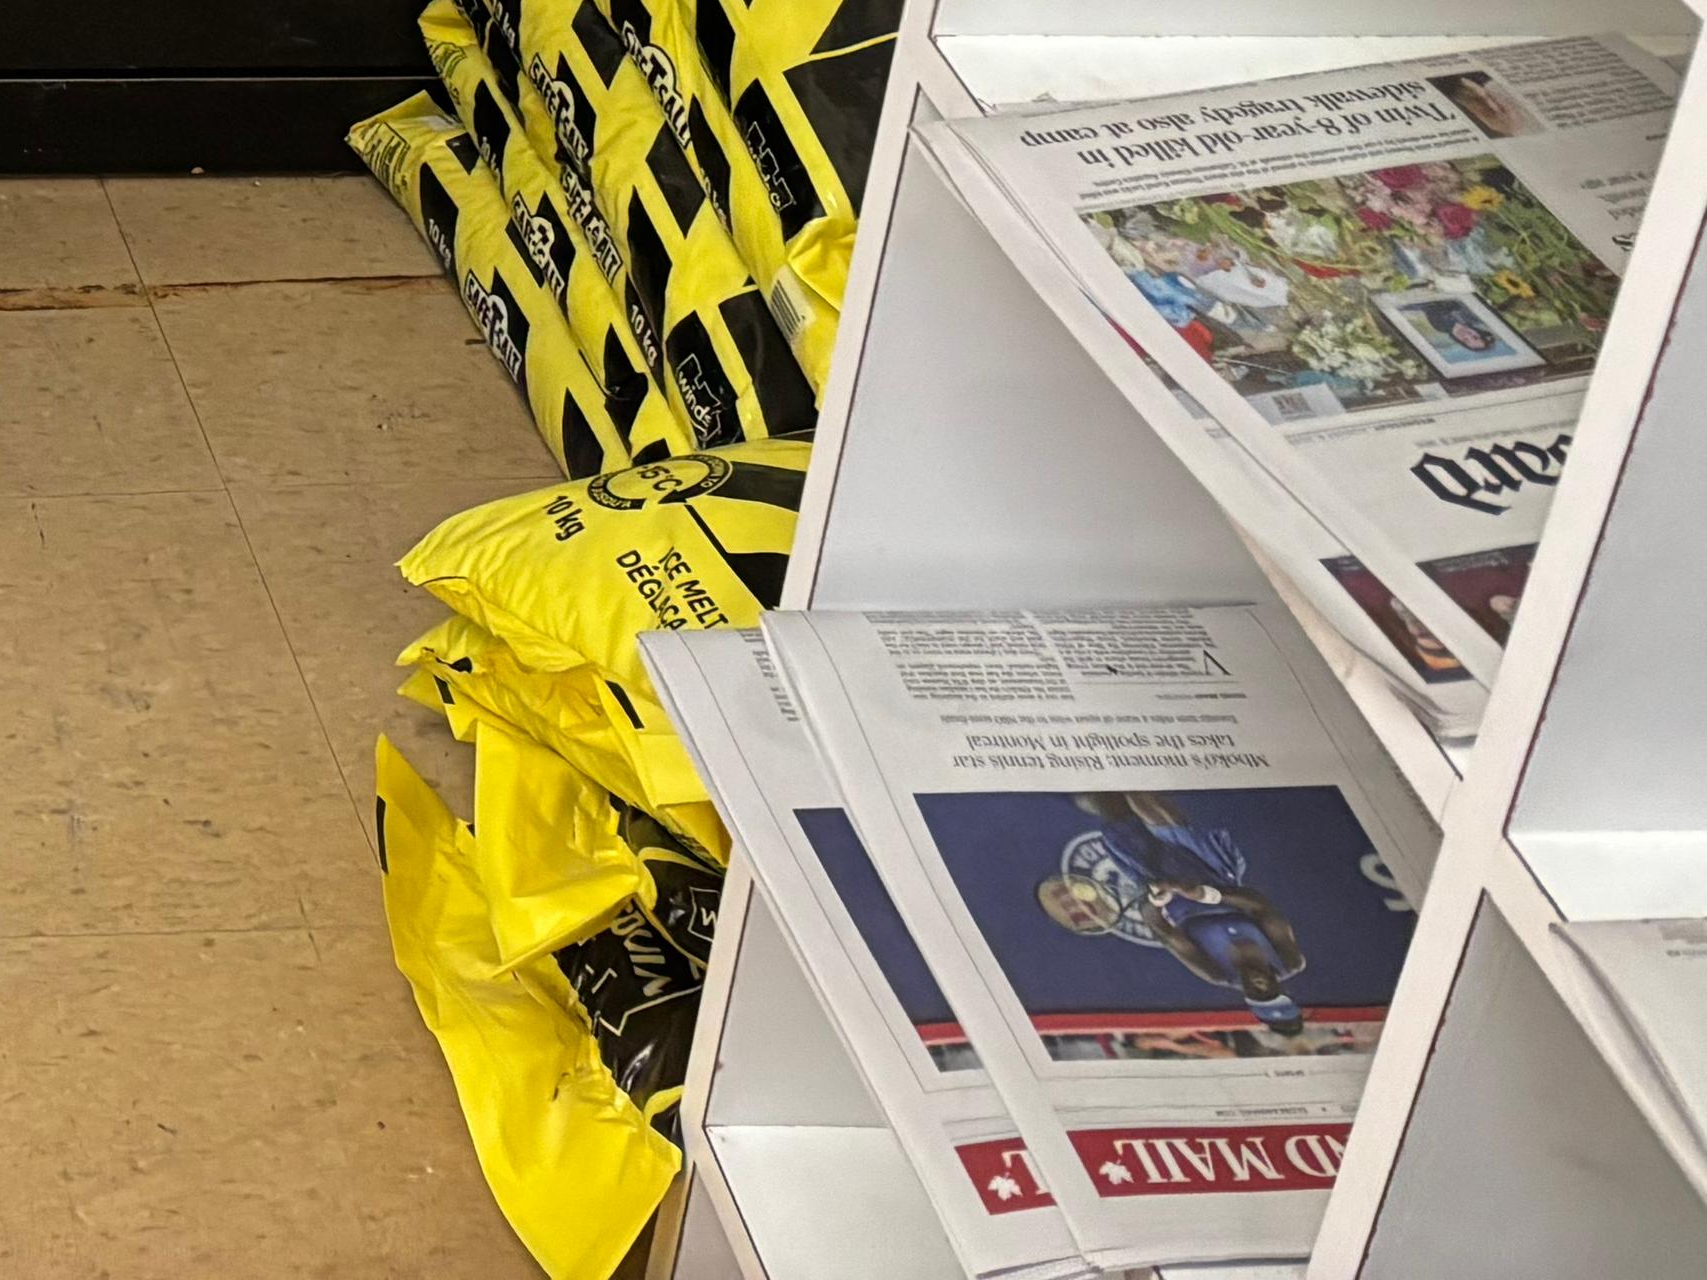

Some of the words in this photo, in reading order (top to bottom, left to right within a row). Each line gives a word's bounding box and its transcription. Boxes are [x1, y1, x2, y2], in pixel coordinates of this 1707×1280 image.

[1199, 89, 1304, 126] tragedy
[1306, 78, 1426, 112] sidewalk
[543, 496, 574, 515] 10
[555, 508, 585, 541] kg
[658, 546, 691, 581] ICE
[676, 579, 729, 630] MELT
[1115, 1138, 1284, 1184] MAIL
